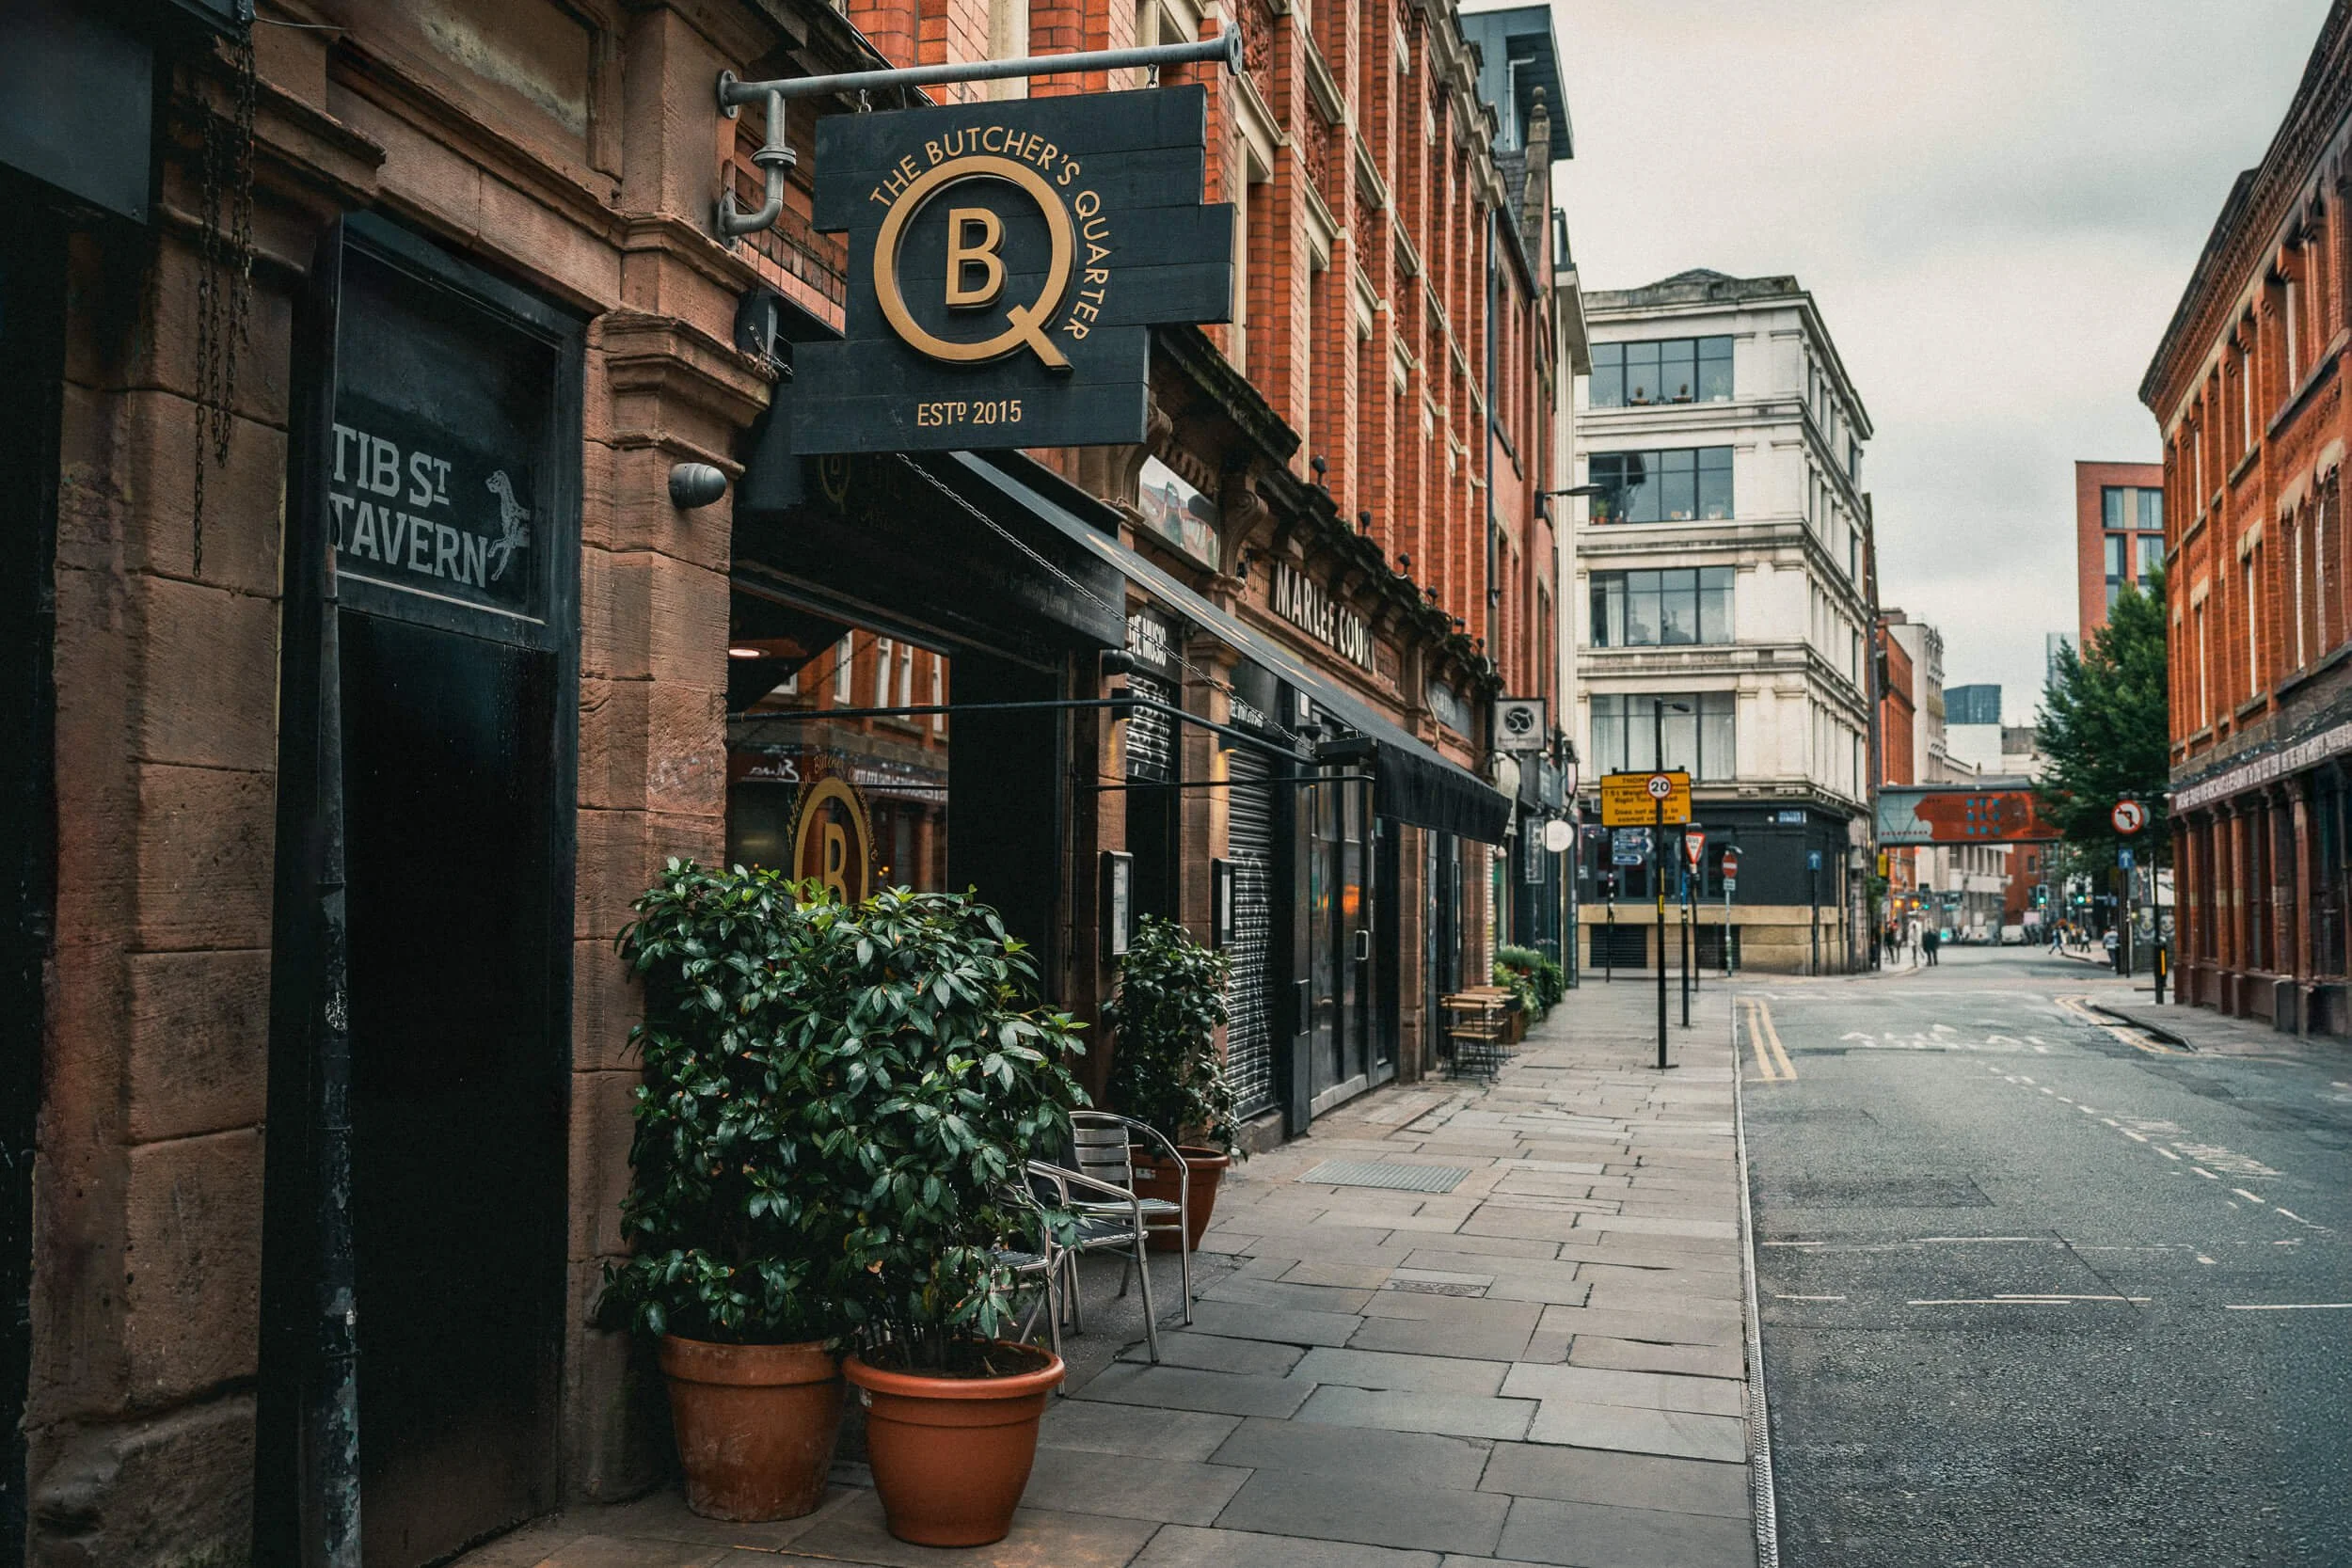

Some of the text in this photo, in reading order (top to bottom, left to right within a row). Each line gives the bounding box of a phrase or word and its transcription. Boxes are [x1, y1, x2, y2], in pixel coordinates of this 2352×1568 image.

[869, 126, 1112, 340] THE BUTCHER'S QUARTER
[973, 400, 1022, 424] 2015
[331, 422, 452, 508] TIB ST
[329, 491, 488, 589] TAVERN
[1276, 561, 1335, 648] MARLEE
[1651, 781, 1670, 792] 20
